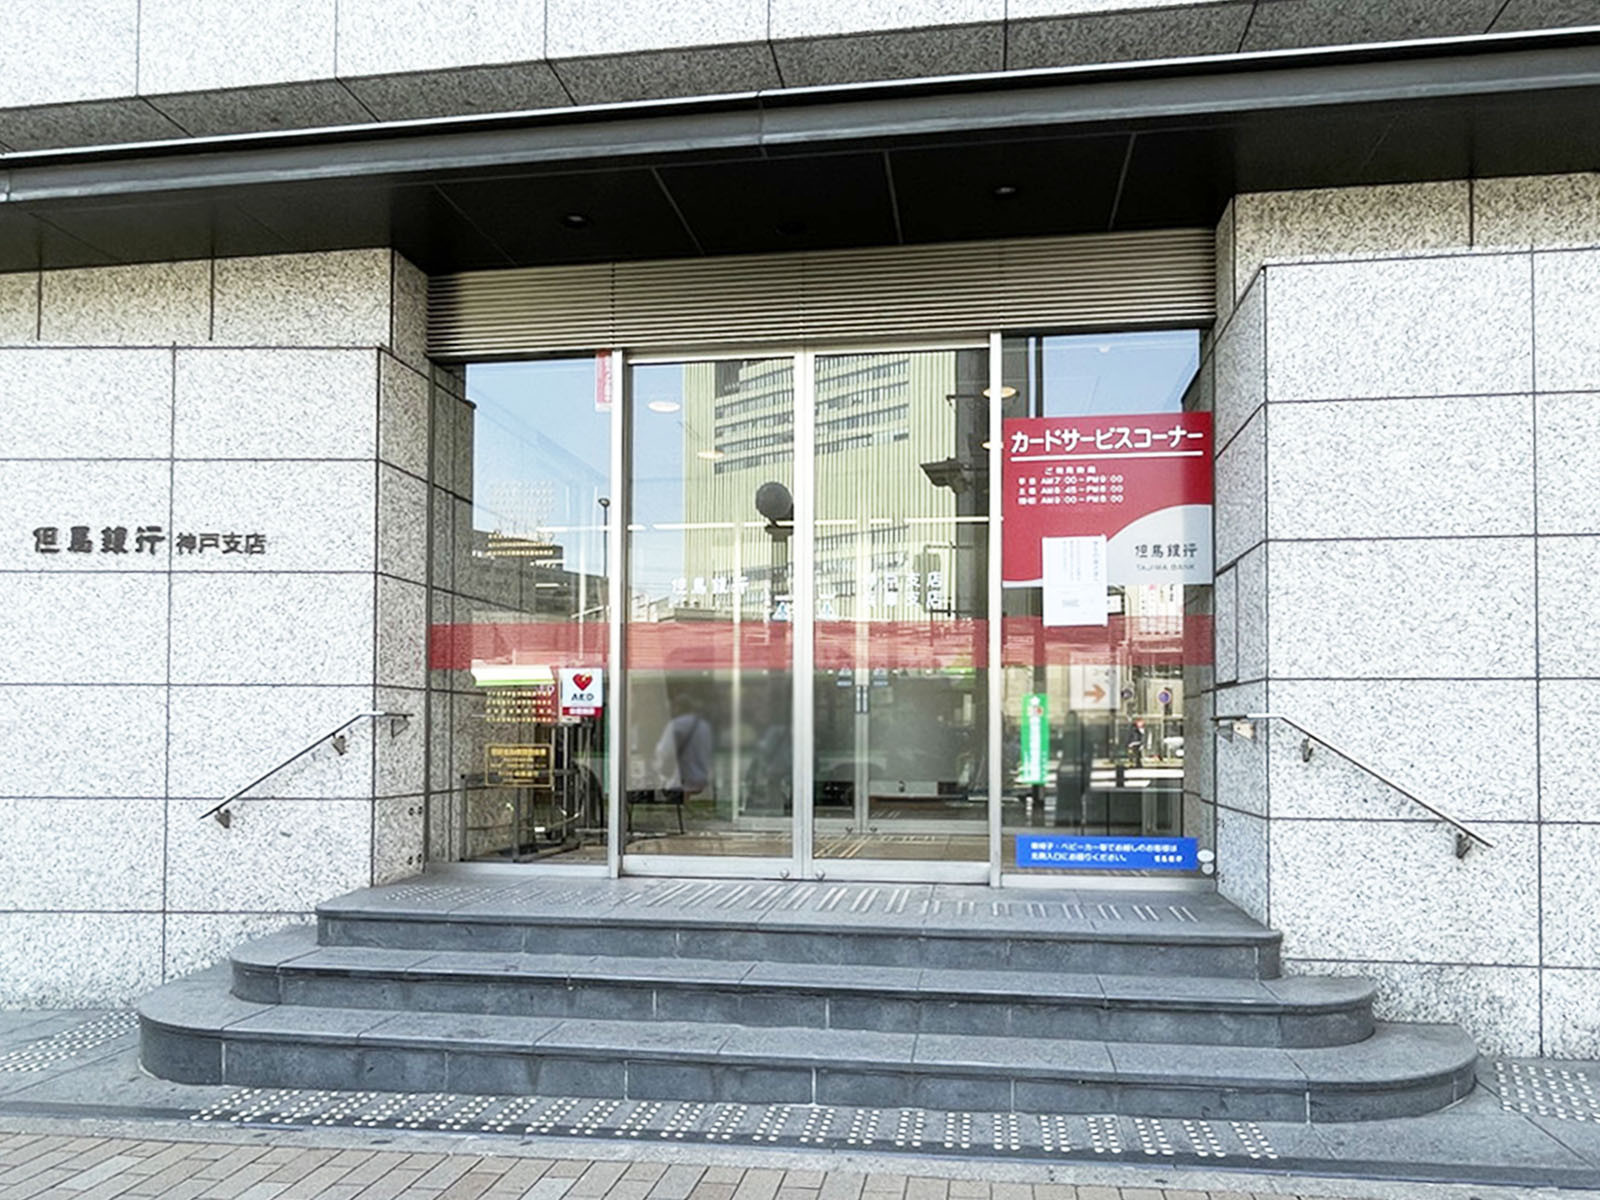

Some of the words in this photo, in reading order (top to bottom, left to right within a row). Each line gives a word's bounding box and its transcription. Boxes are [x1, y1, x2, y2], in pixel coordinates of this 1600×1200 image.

[1010, 425, 1204, 453] カードサービスコーナー
[176, 532, 266, 554] 神戸支店
[1135, 543, 1198, 559] 但馬銀行
